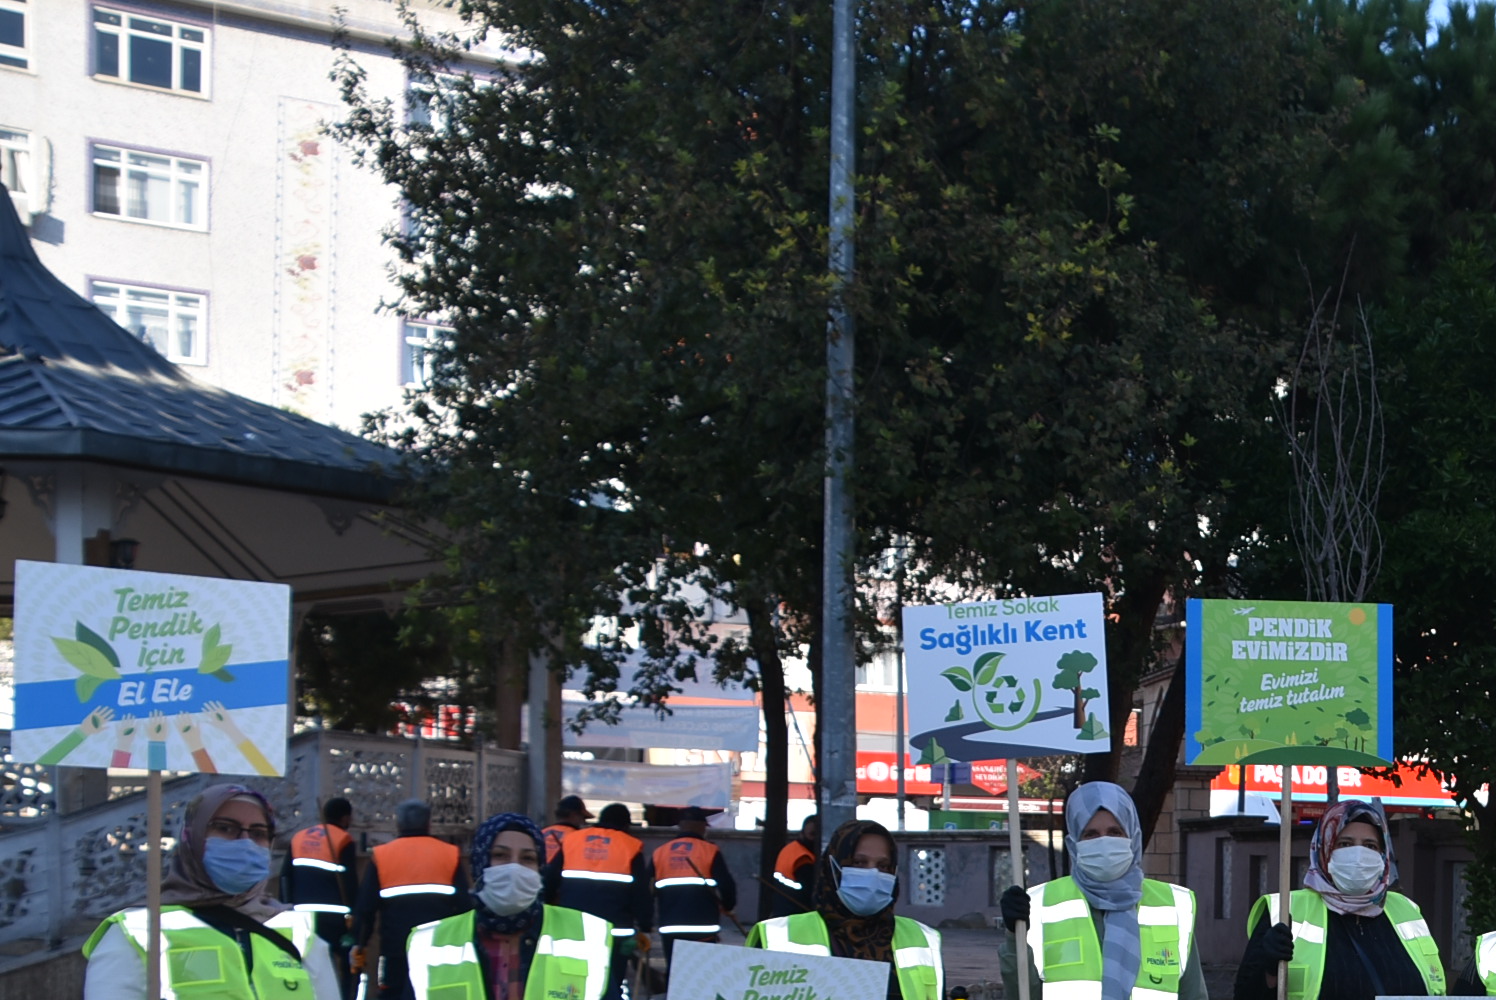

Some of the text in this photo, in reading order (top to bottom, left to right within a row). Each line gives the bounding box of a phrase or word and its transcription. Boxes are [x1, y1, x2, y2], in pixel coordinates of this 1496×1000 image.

[113, 586, 190, 613] Temiz
[944, 597, 1060, 619] Temiz Sokak
[108, 611, 204, 641] Pendik
[919, 619, 1088, 655] Sağlıklı Kent
[117, 678, 194, 706] El Ele
[1259, 668, 1320, 692] Evimizi
[1239, 685, 1346, 713] temiz tutalım
[748, 964, 809, 987] Temiz
